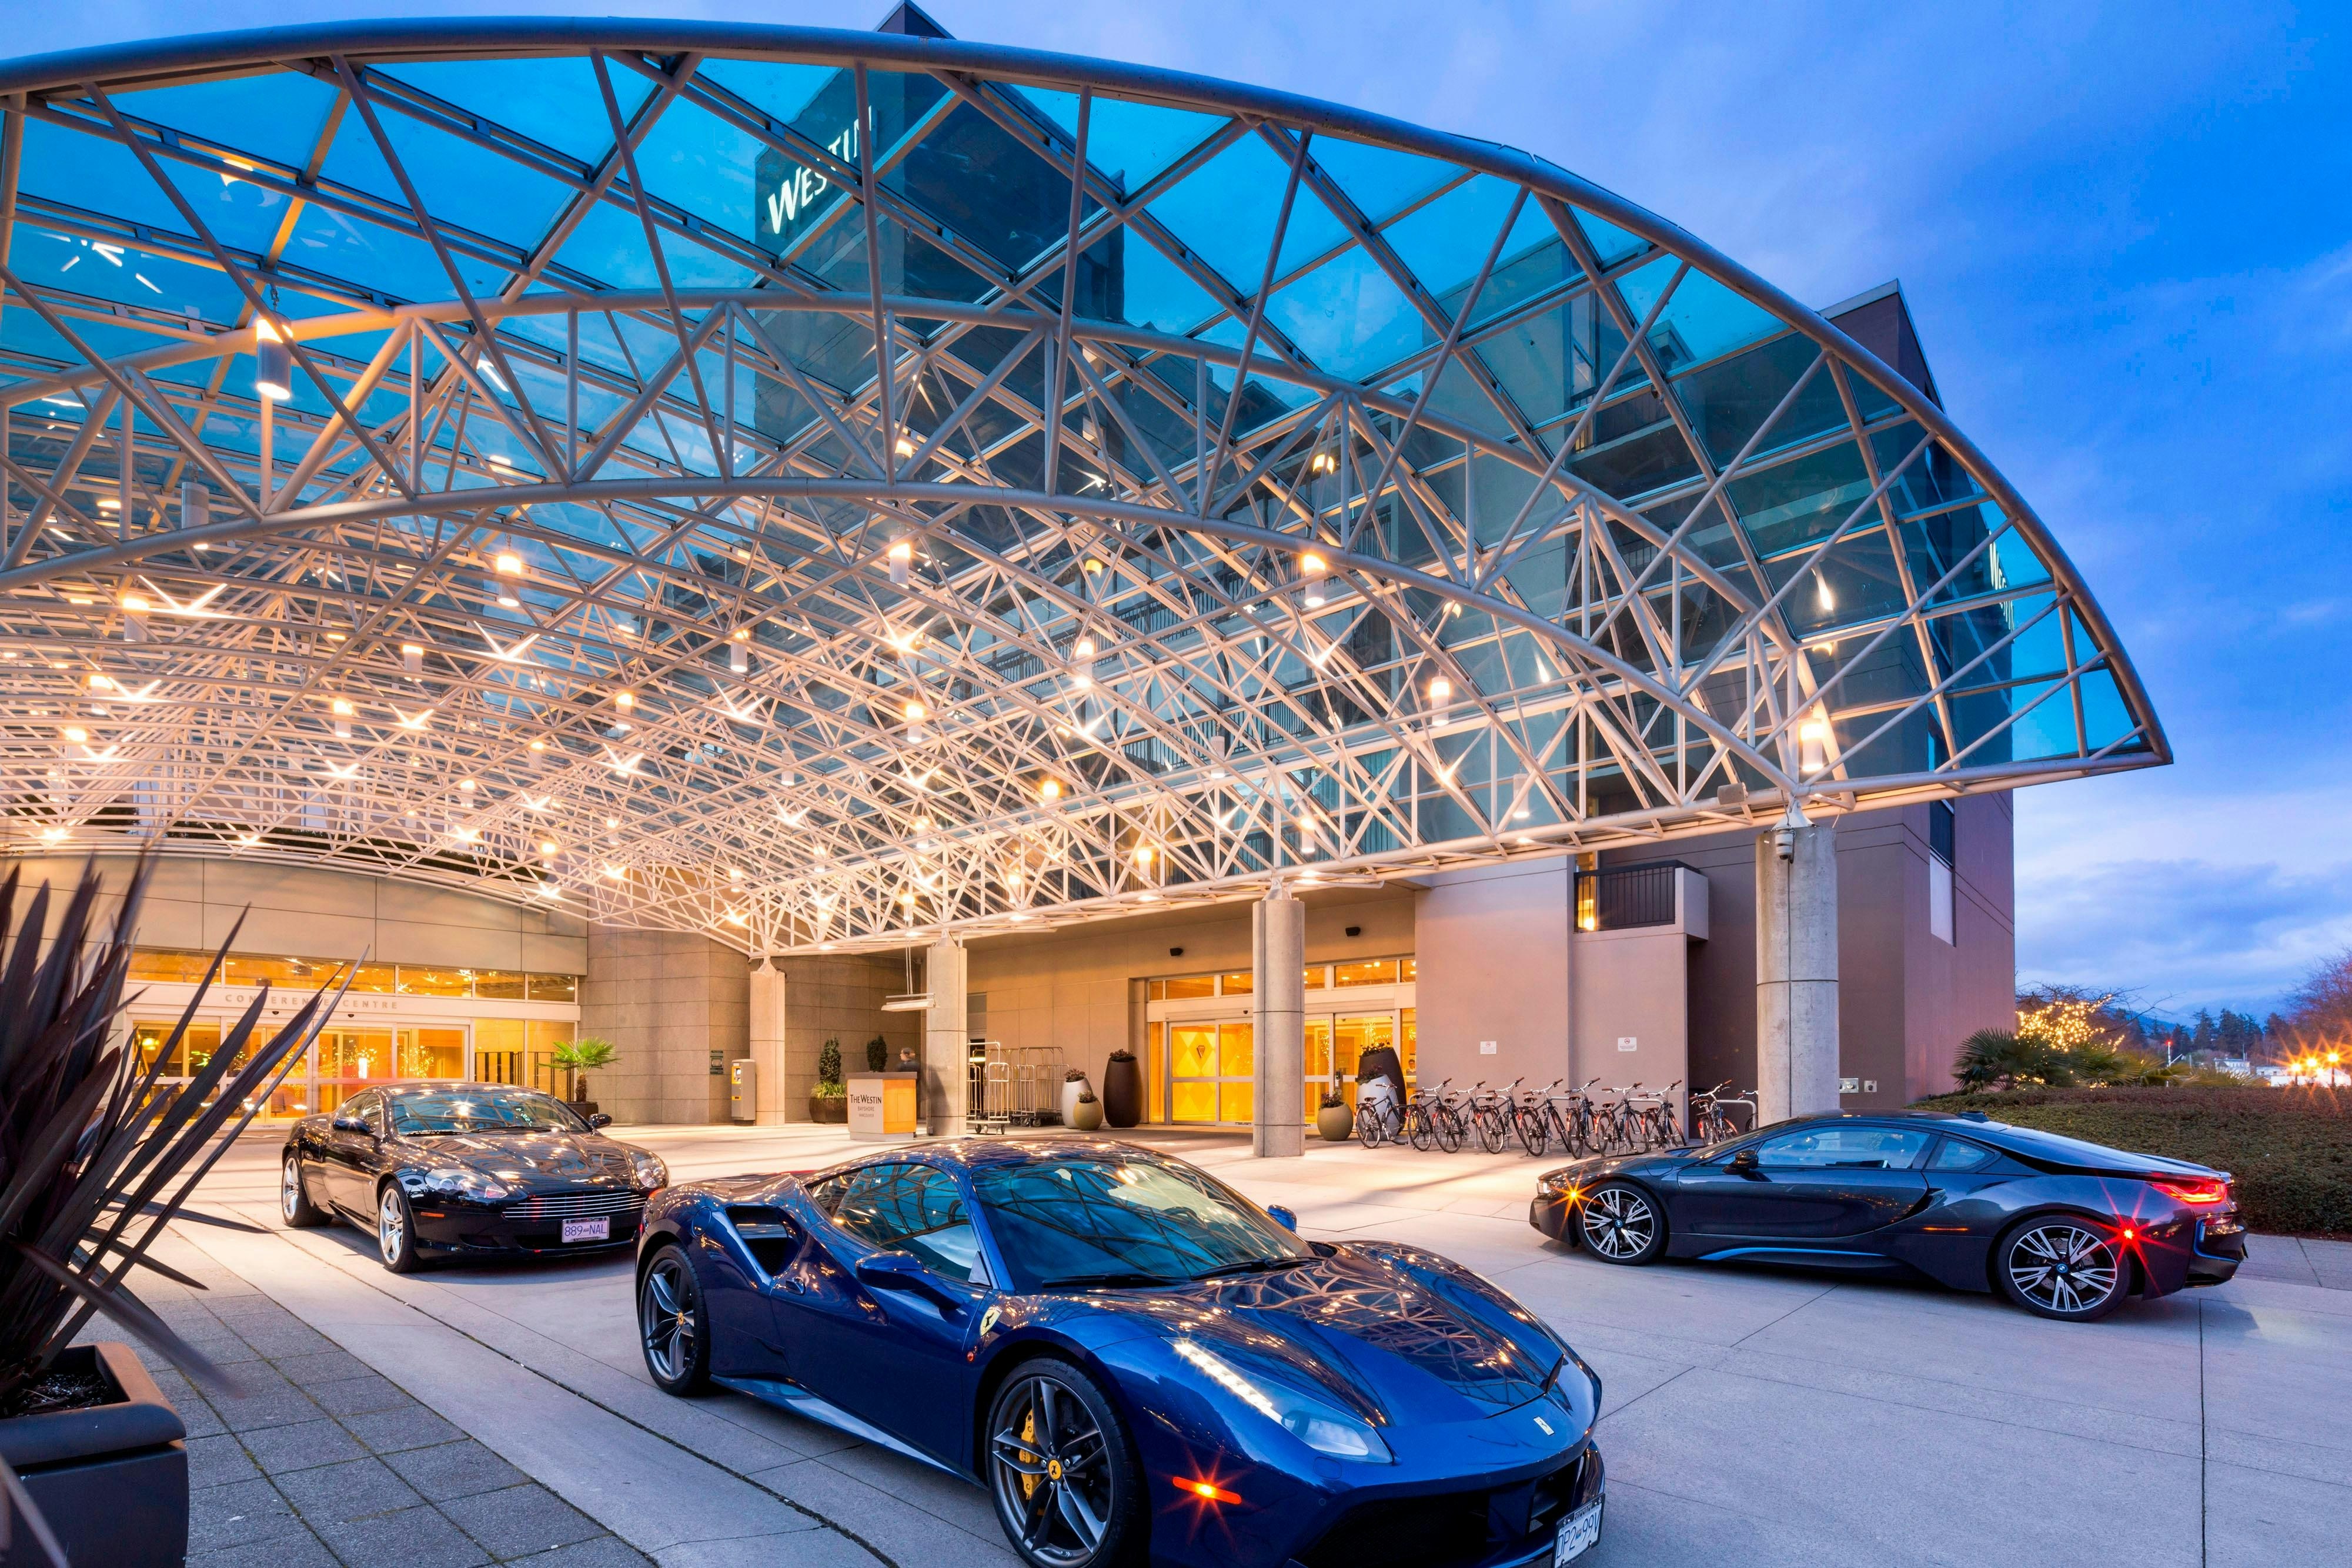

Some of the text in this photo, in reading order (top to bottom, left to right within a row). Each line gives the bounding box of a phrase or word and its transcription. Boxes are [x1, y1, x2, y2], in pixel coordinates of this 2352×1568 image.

[225, 994, 397, 1008] CONERENE CENTRE
[850, 1094, 881, 1104] THE WESTIN
[565, 1223, 607, 1236] 889 NAL
